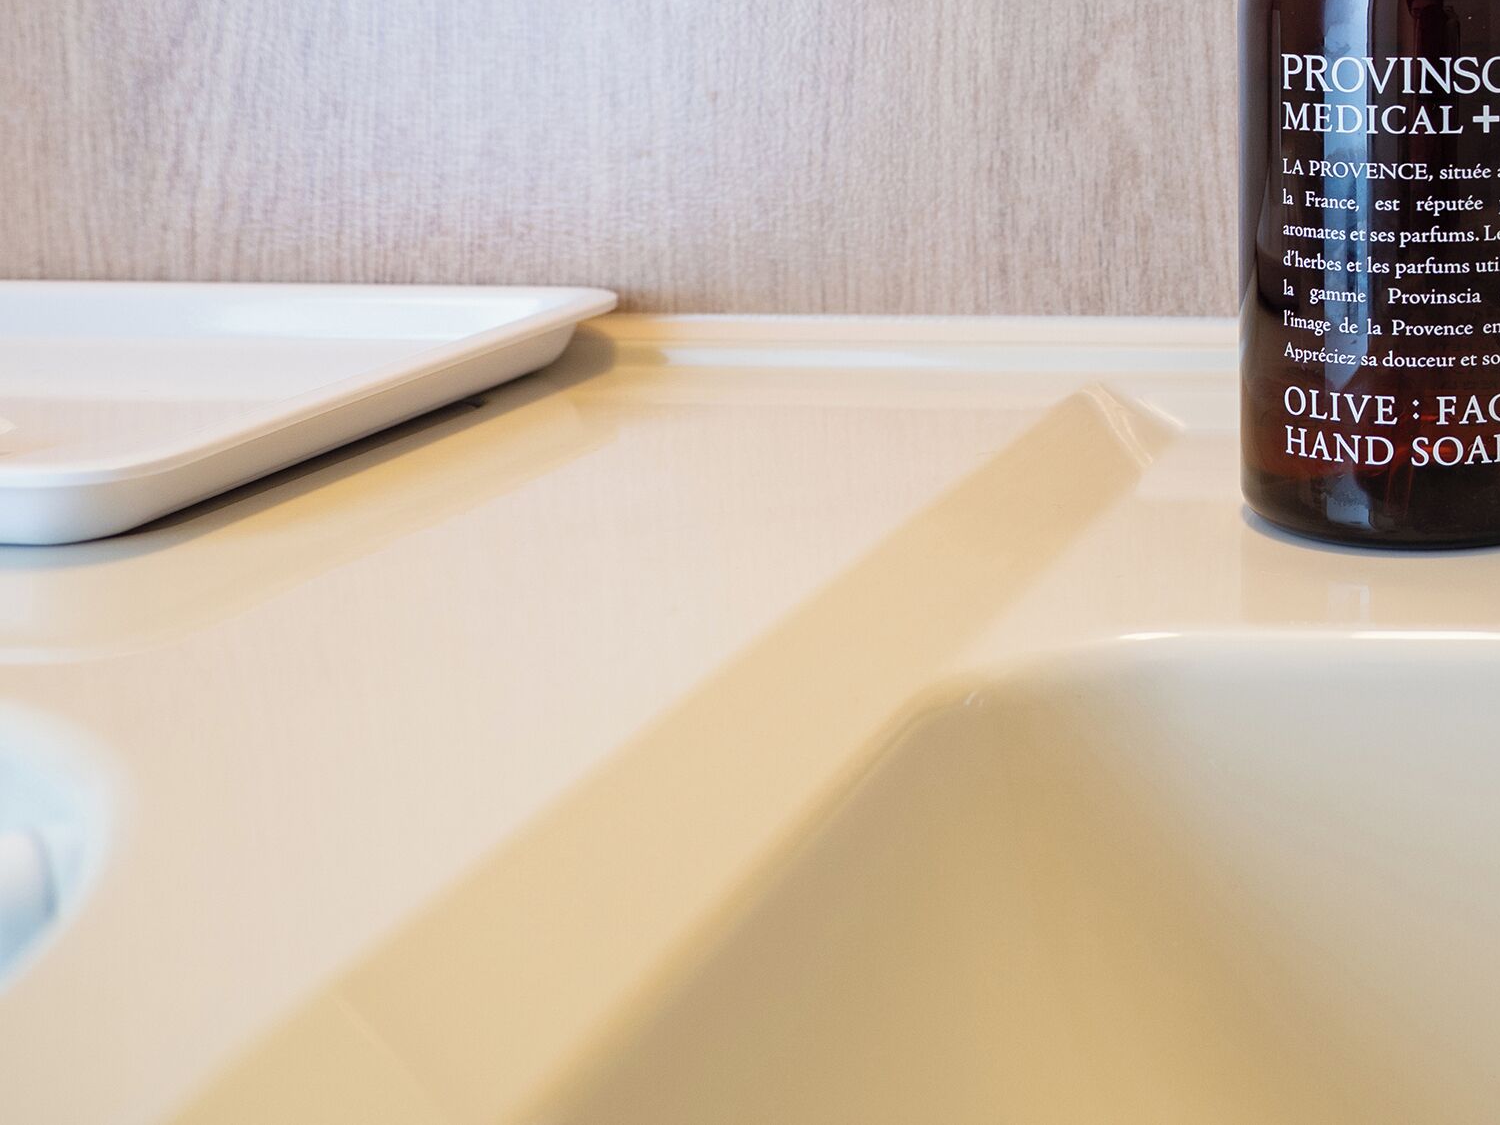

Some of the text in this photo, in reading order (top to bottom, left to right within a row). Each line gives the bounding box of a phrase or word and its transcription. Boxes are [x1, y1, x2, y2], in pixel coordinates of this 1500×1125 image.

[1282, 100, 1464, 135] MEDICAL
[1282, 157, 1304, 177] LA
[1308, 159, 1434, 183] PROVENCE,
[1439, 162, 1492, 181] située
[1282, 188, 1294, 206] la
[1305, 190, 1360, 213] France,
[1374, 197, 1401, 212] est
[1415, 194, 1484, 217] réputée
[1282, 222, 1347, 242] aromates
[1349, 228, 1367, 243] et
[1369, 230, 1396, 244] ses
[1398, 225, 1480, 249] parfums.
[1283, 250, 1342, 272] d'herbes
[1346, 259, 1363, 274] et
[1366, 257, 1391, 275] les
[1394, 256, 1471, 280] parfums
[1283, 278, 1294, 297] la
[1309, 286, 1367, 306] gamme
[1387, 287, 1482, 305] Provinscia
[1283, 309, 1332, 336] l'image
[1338, 317, 1359, 335] de
[1366, 318, 1383, 336] la
[1391, 319, 1474, 337] Provence
[1284, 342, 1356, 366] Appréciez
[1360, 353, 1378, 368] sa
[1382, 351, 1457, 369] douceur
[1460, 354, 1478, 367] et
[1283, 385, 1398, 426] OLIVE
[1284, 424, 1395, 466] HAND
